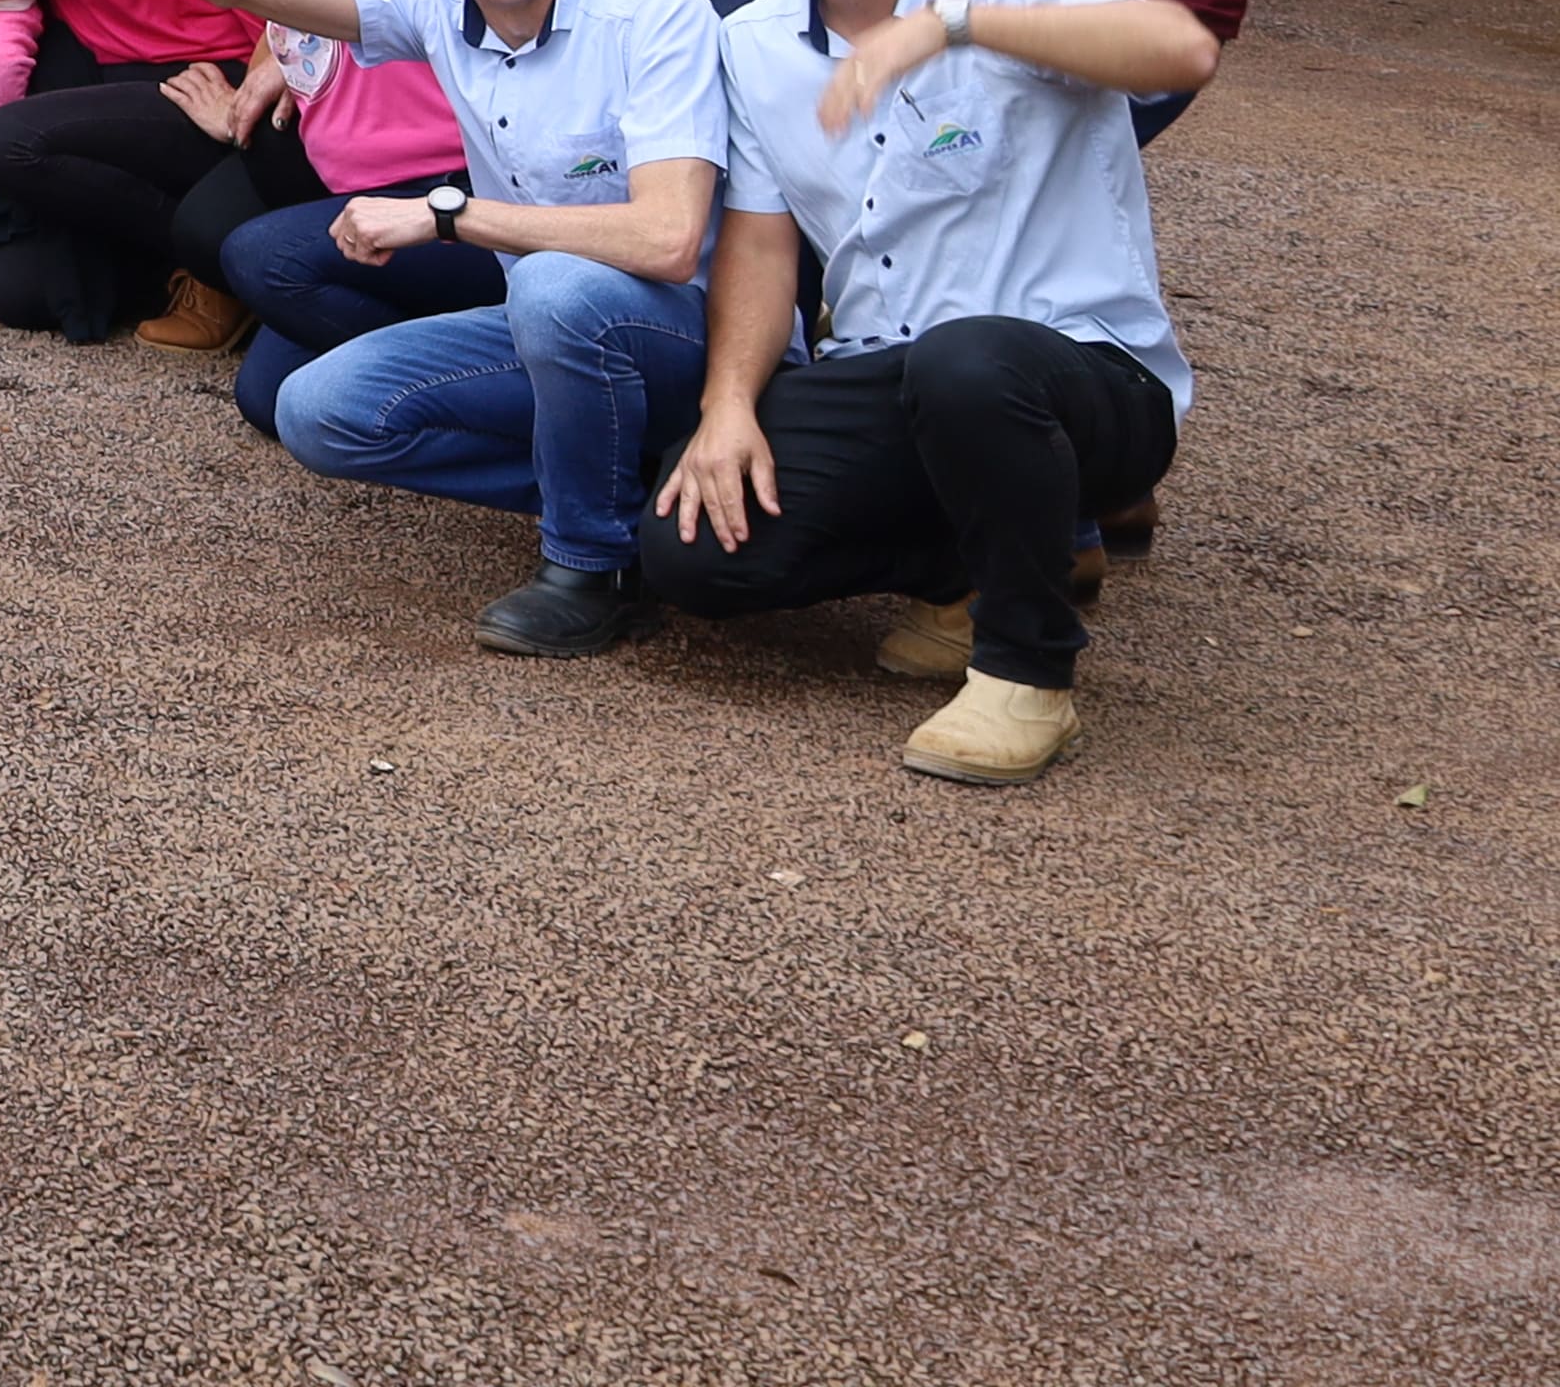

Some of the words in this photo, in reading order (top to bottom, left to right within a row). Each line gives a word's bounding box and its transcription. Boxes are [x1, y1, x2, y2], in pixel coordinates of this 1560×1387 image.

[923, 143, 959, 158] COOPER
[960, 130, 983, 147] A1
[564, 170, 599, 179] COOPER
[599, 160, 618, 175] A1
